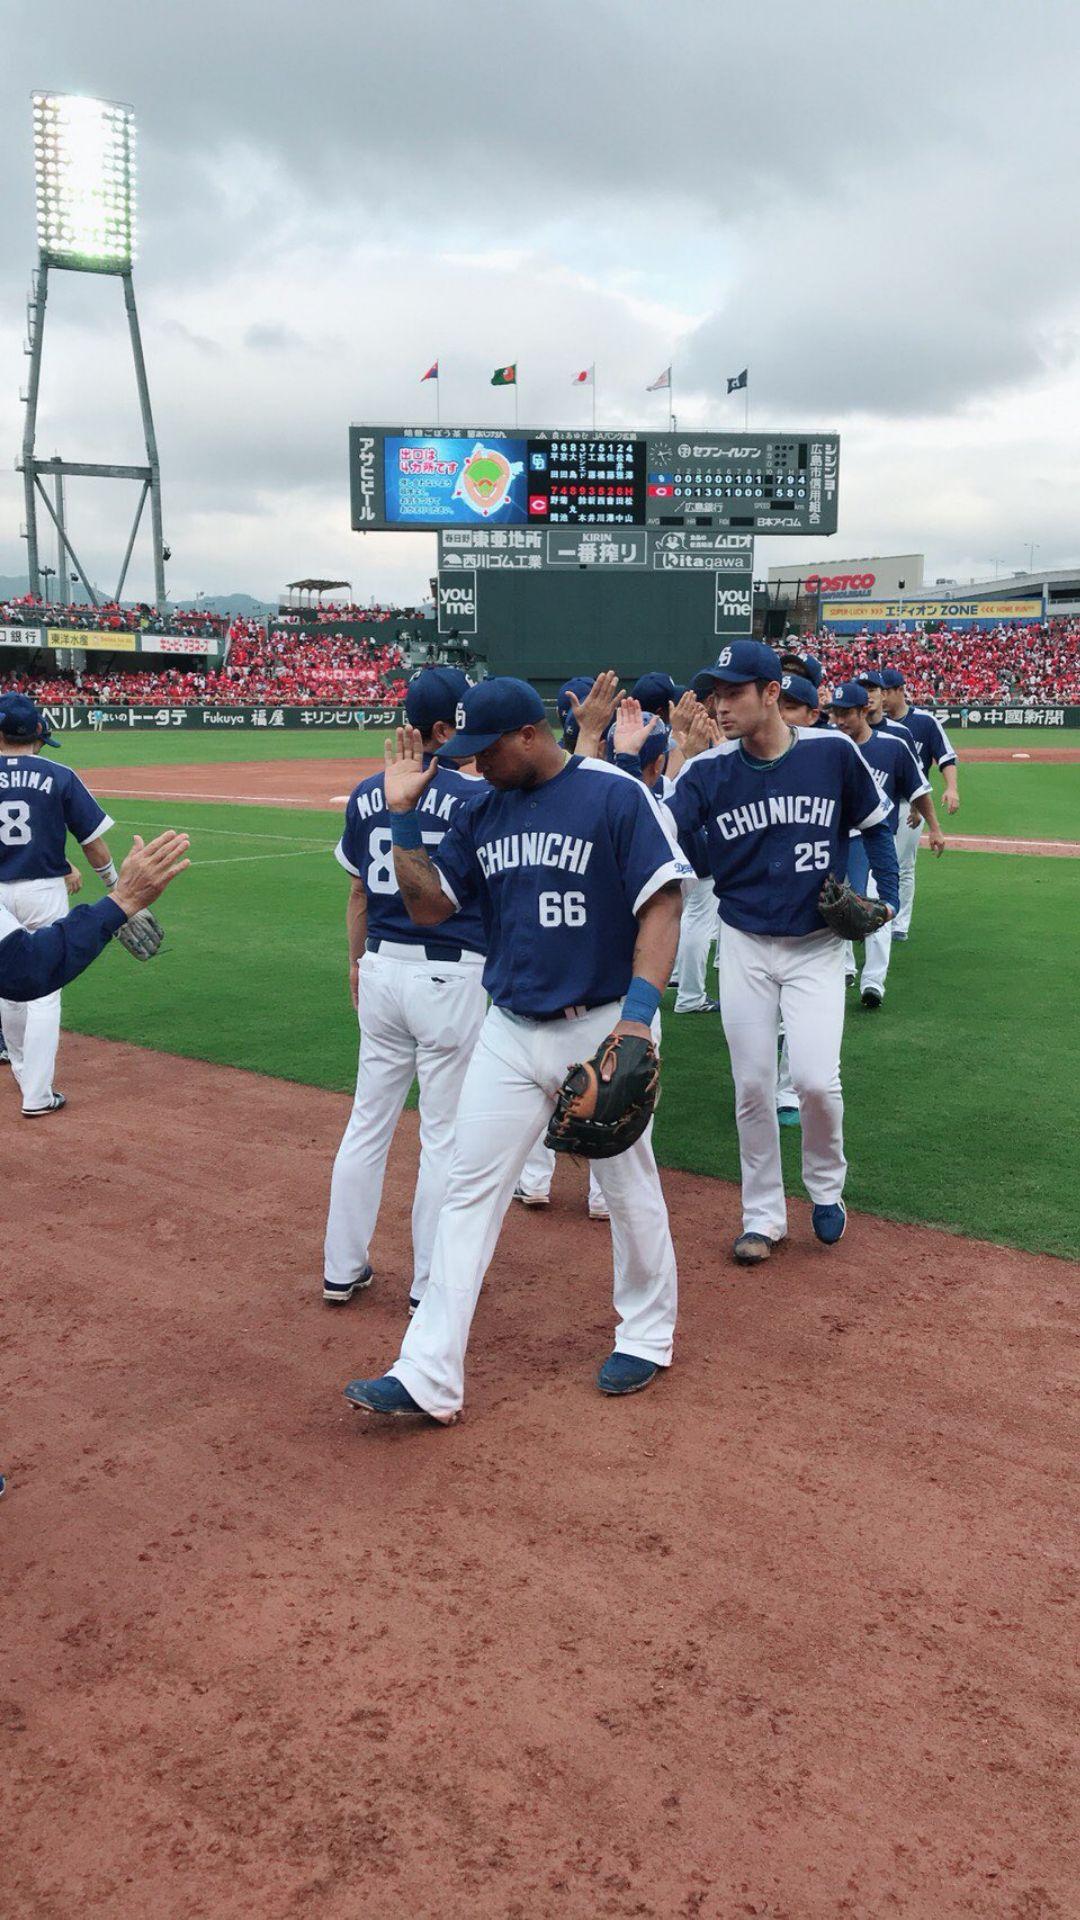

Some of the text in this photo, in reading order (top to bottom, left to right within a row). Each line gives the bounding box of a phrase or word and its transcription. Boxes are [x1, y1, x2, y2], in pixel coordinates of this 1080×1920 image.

[551, 443, 633, 453] 9 6 8 3 7 5 1 2 4
[359, 437, 376, 521] アサヒビール
[675, 475, 805, 483] 0 0 5 0 0 0 1 0 1 7 9 4
[809, 443, 823, 525] 広島市信用組合
[675, 488, 805, 497] 0 0 1 3 0 1 0 0 0 5 8 0
[757, 517, 802, 527] 日本アイコム
[472, 530, 543, 548] 東亜地所
[582, 532, 612, 542] KIRIN
[715, 534, 752, 548] ムロオ
[463, 553, 543, 569] 西川ゴム工業
[558, 543, 637, 563] 一番搾り
[805, 573, 876, 593] COSTCO
[440, 588, 473, 604] you
[717, 589, 749, 606] you
[446, 602, 475, 615] me
[723, 604, 751, 616] me
[885, 605, 978, 617] エディオン ZONE
[129, 708, 188, 727] トータテ
[203, 709, 285, 727] Fukuya 福屋
[983, 708, 1065, 726] 中國新聞
[0, 770, 54, 794] SHIMA
[716, 795, 836, 841] CHUNICHI
[476, 831, 594, 880] CHUNICHI
[794, 839, 831, 873] 25
[538, 890, 587, 928] 66
